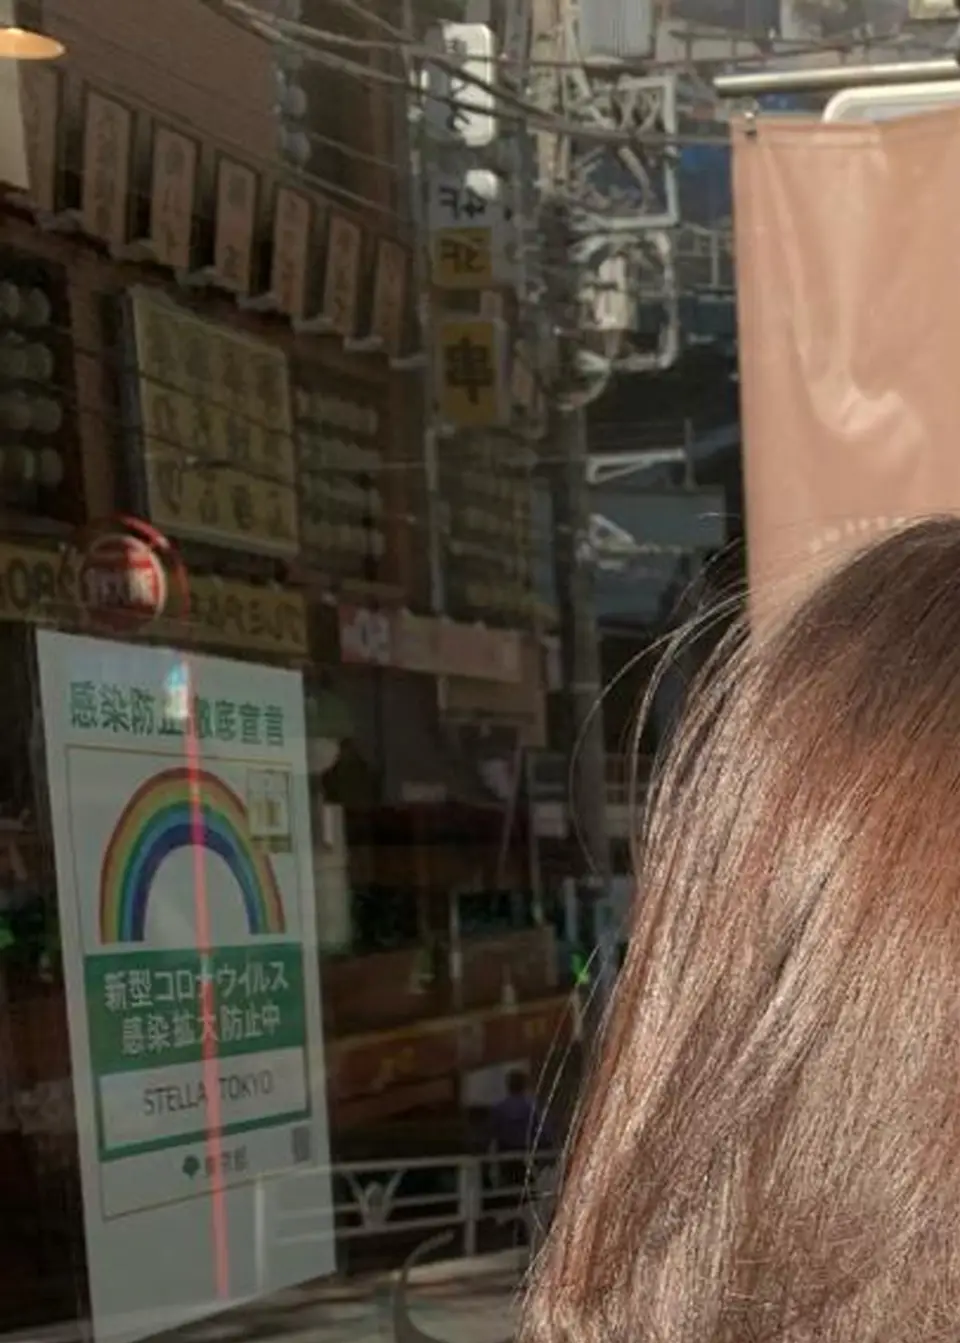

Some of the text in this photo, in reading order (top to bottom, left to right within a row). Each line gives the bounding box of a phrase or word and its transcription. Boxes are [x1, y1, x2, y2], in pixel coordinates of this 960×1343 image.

[103, 961, 289, 1012] 新型コロナウイルス
[121, 1001, 282, 1057] 感染拡大防止中
[144, 1069, 274, 1116] STELLA TOKYO
